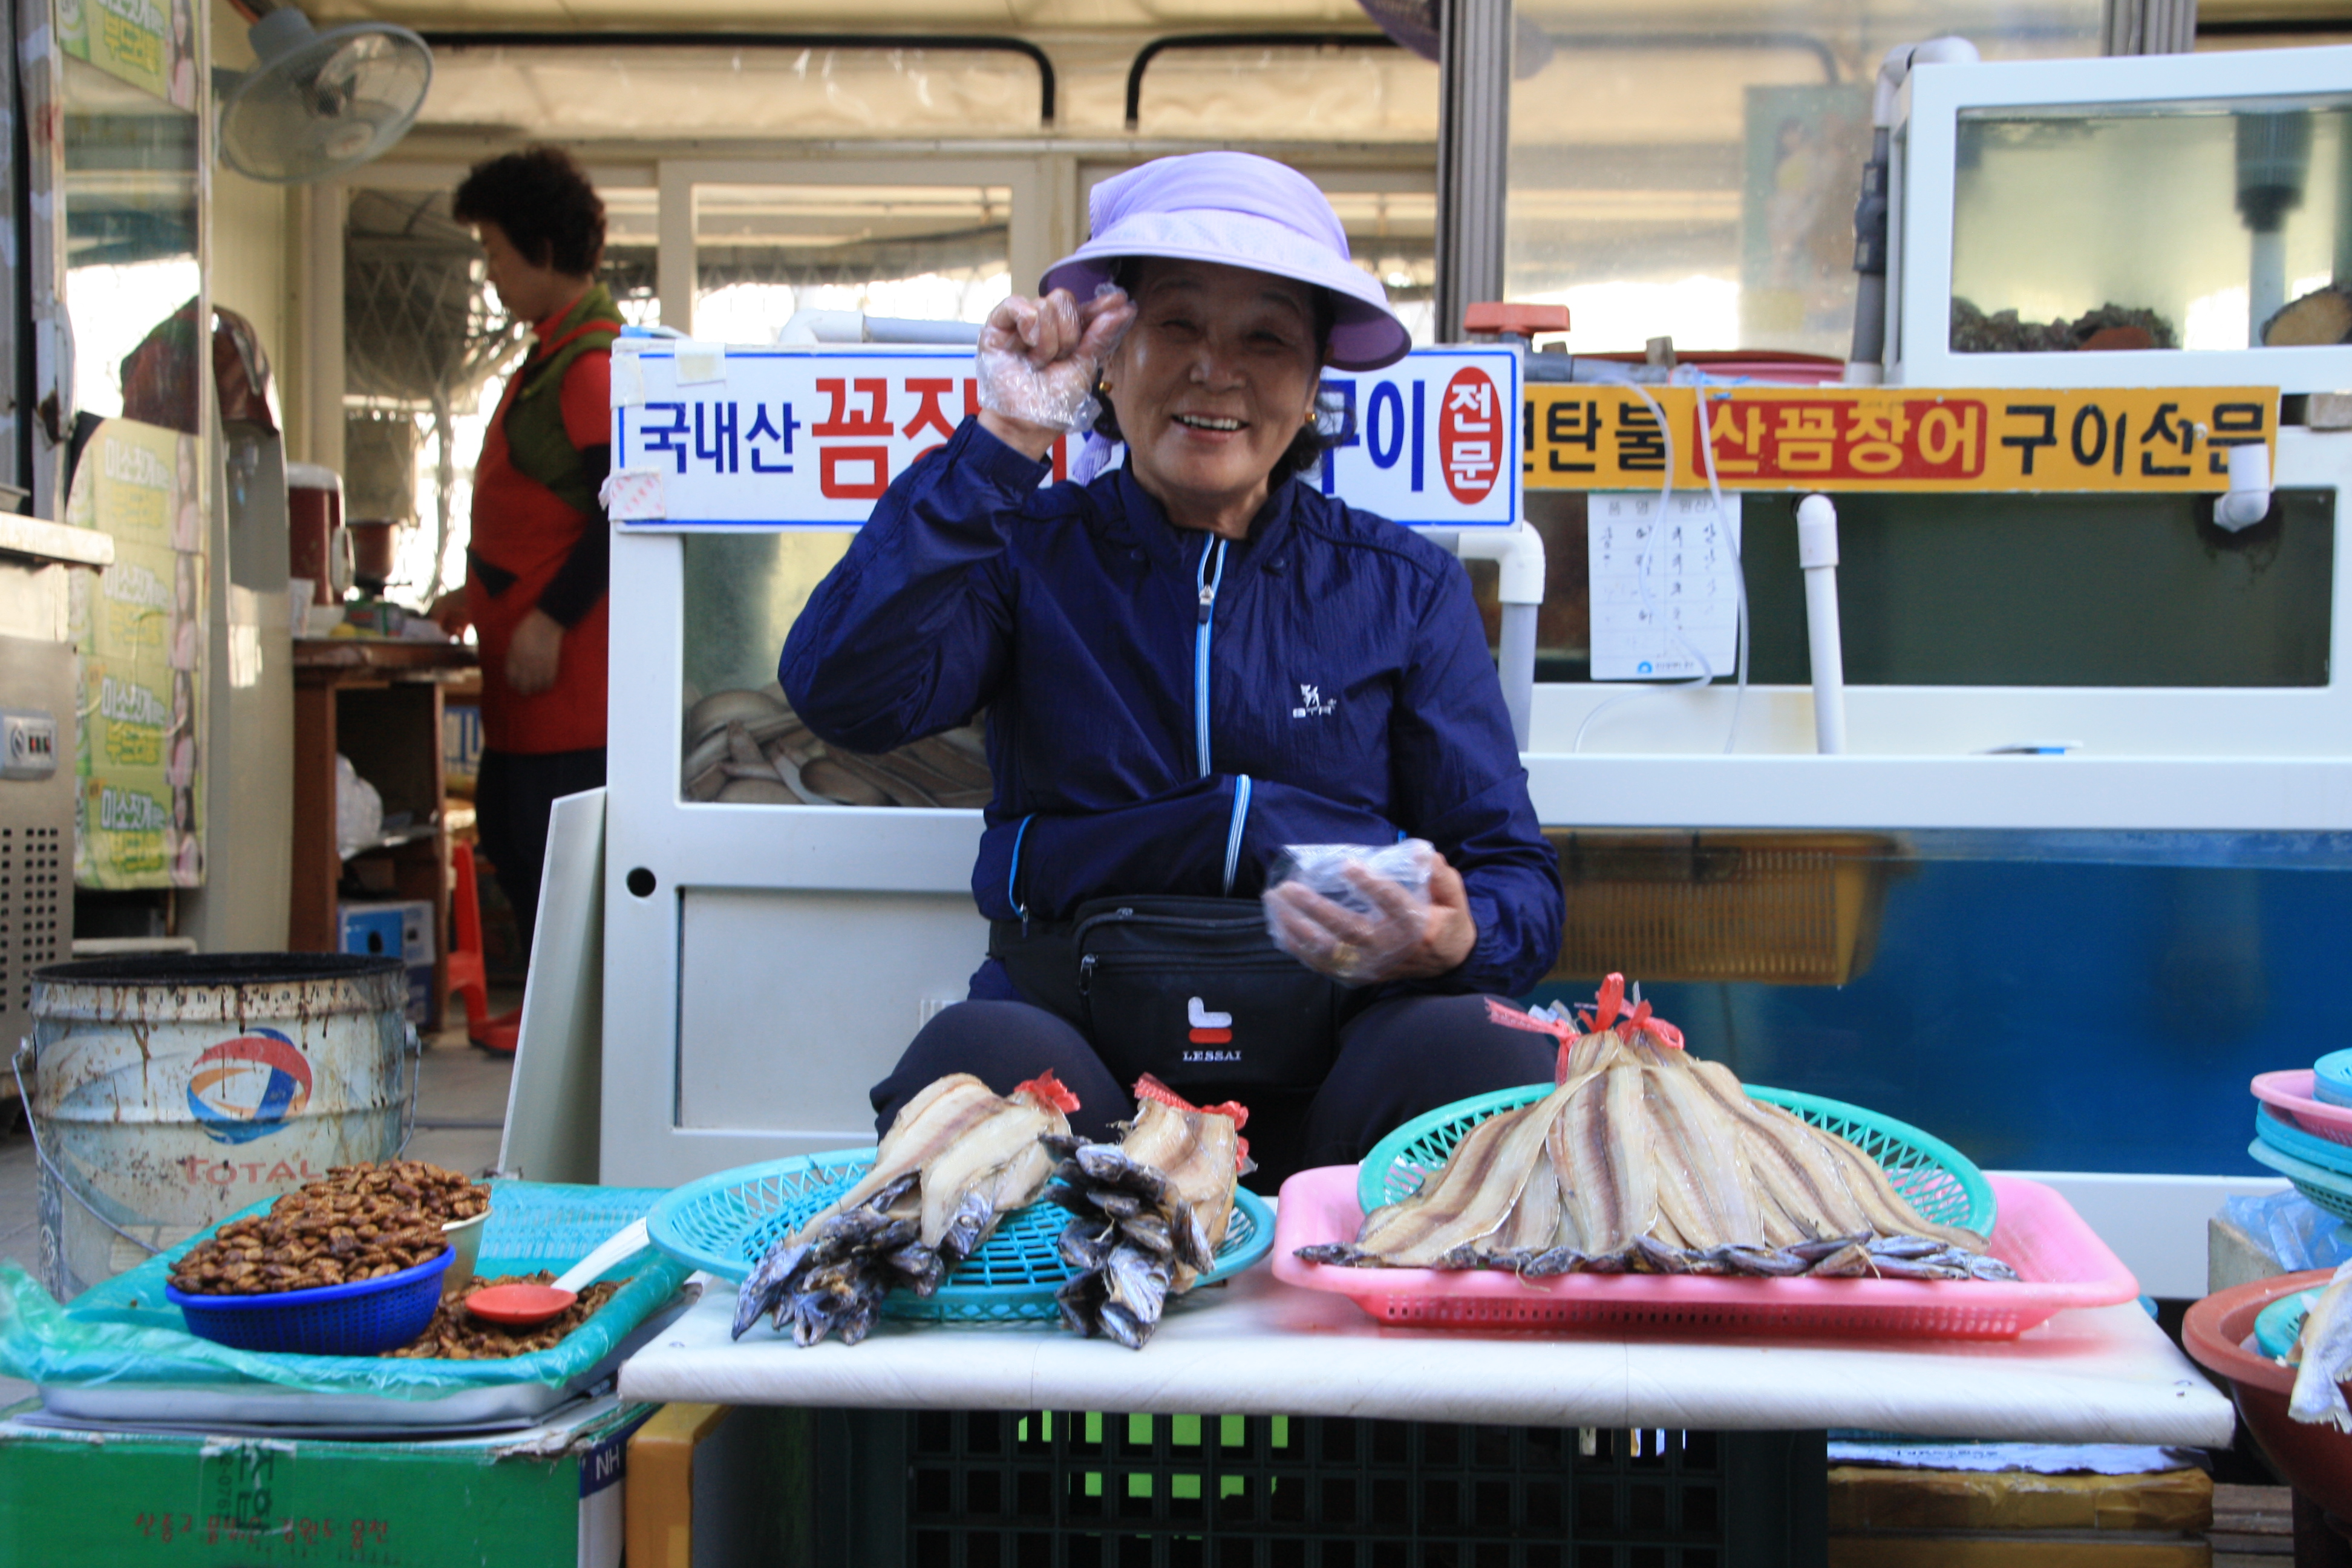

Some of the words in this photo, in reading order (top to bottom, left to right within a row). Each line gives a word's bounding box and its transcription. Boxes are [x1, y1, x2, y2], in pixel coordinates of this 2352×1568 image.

[640, 402, 800, 474] 국내산
[1449, 382, 1494, 491] 전문
[1708, 403, 1979, 474] 산꼼장어
[1183, 1051, 1241, 1061] LESSAI
[176, 1155, 322, 1185] TOTAL
[596, 1443, 619, 1481] NH
